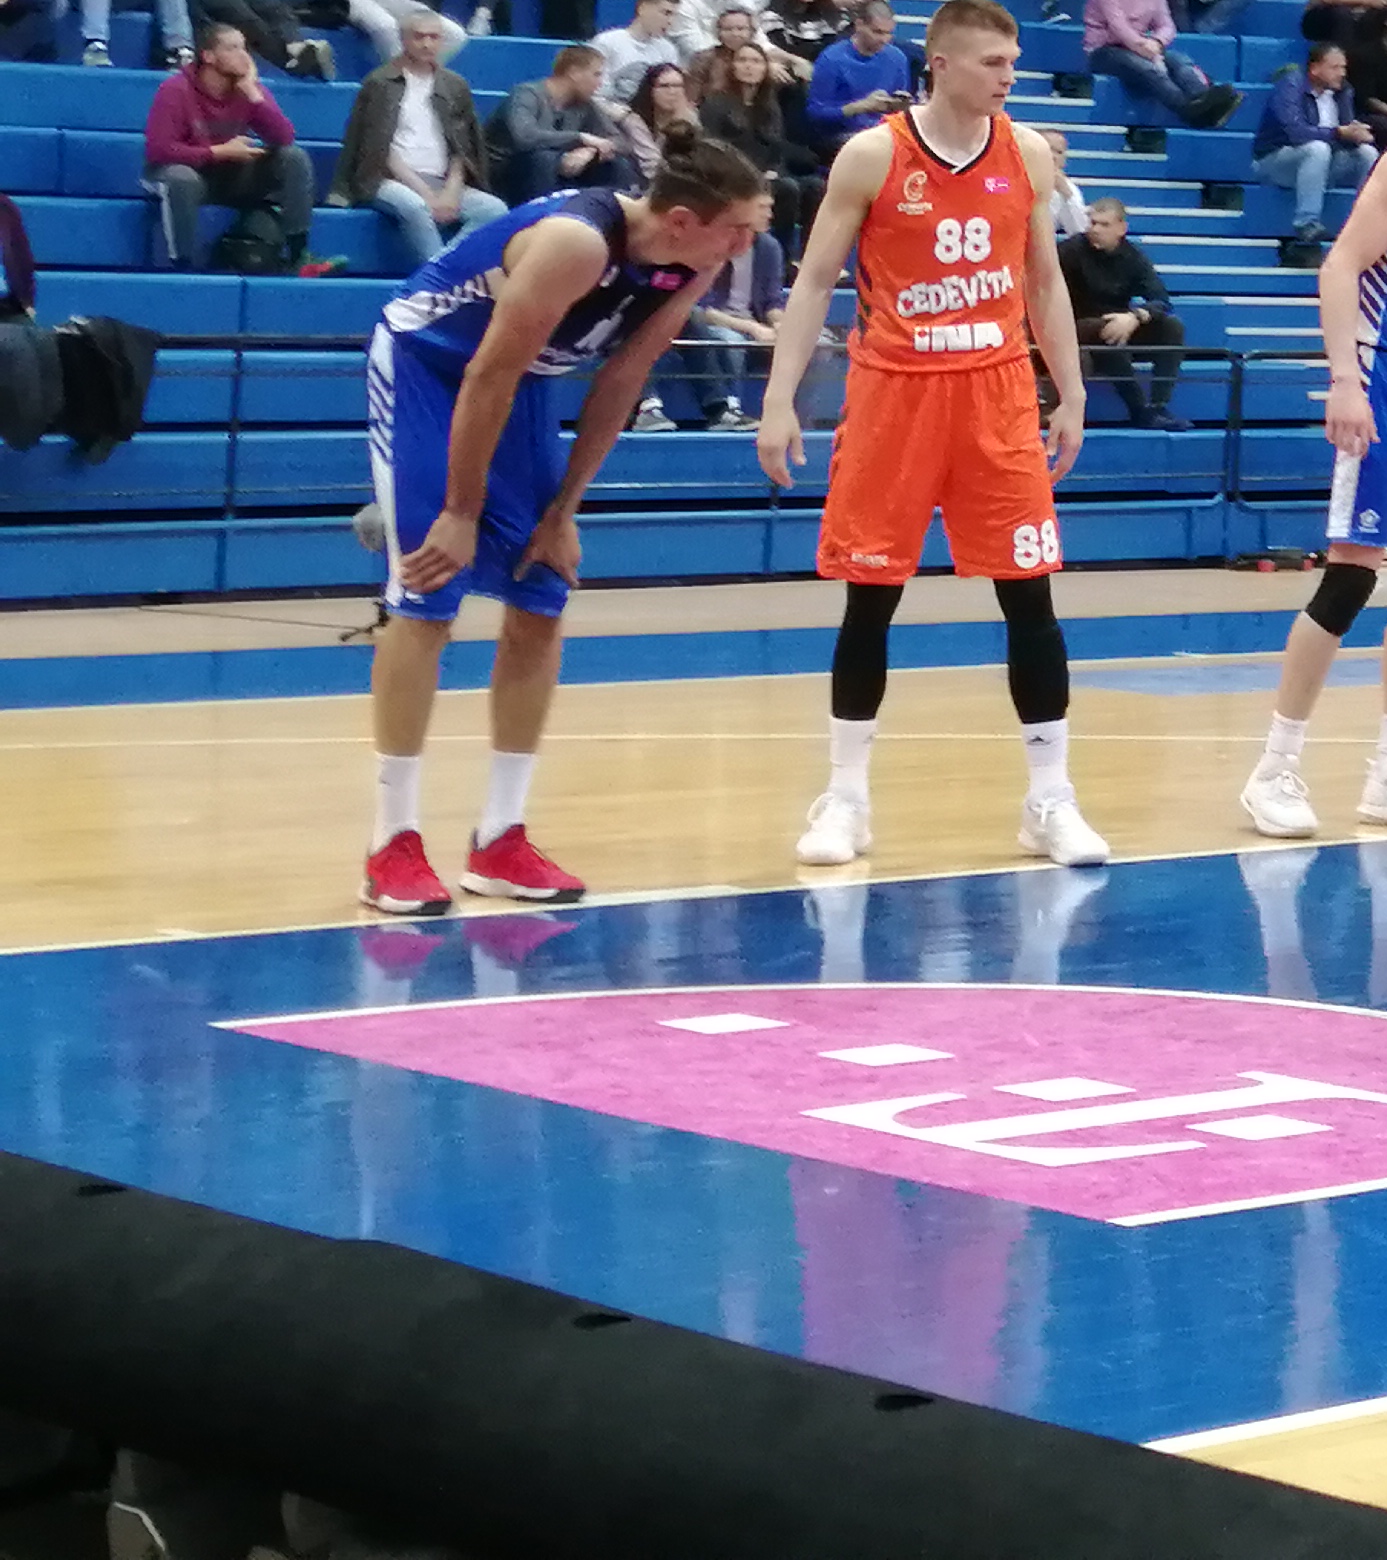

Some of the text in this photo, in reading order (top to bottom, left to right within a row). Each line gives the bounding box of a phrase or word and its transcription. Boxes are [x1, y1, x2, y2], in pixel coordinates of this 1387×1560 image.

[933, 216, 993, 265] 88
[896, 265, 1014, 318] CEDEVITA
[1013, 518, 1060, 570] 88
